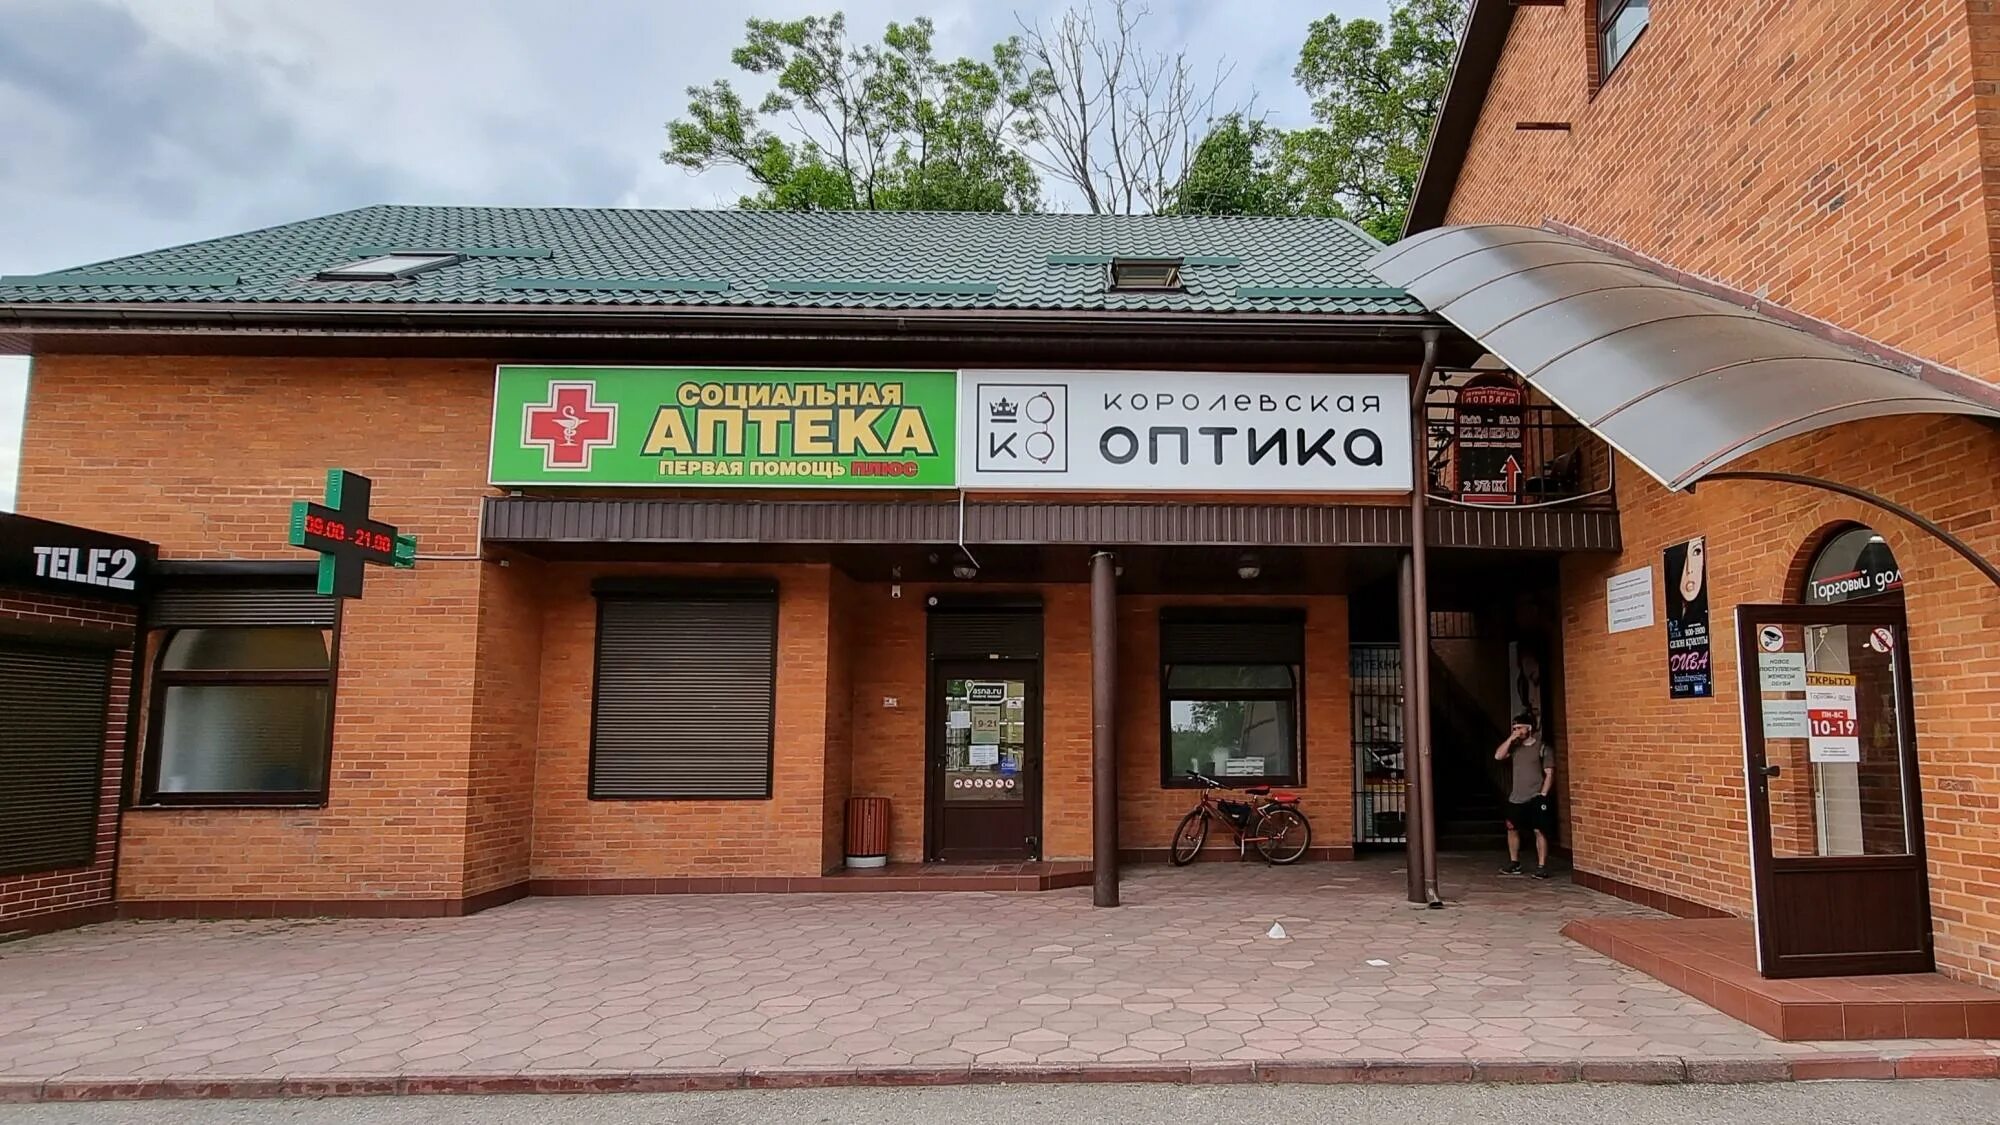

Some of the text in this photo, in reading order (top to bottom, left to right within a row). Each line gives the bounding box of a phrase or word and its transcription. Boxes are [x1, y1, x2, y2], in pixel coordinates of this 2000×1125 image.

[676, 382, 903, 408] СОЦИАЛЬНАЯ
[640, 405, 938, 457] АПТЕКА
[658, 460, 918, 479] ПЕРВАЯ ПОМОЩЬ ПЛЮС
[33, 546, 136, 590] TELE2
[1811, 569, 1871, 602] Торговый
[1671, 651, 1708, 672] ДИВА
[1812, 720, 1856, 736] 10-19
